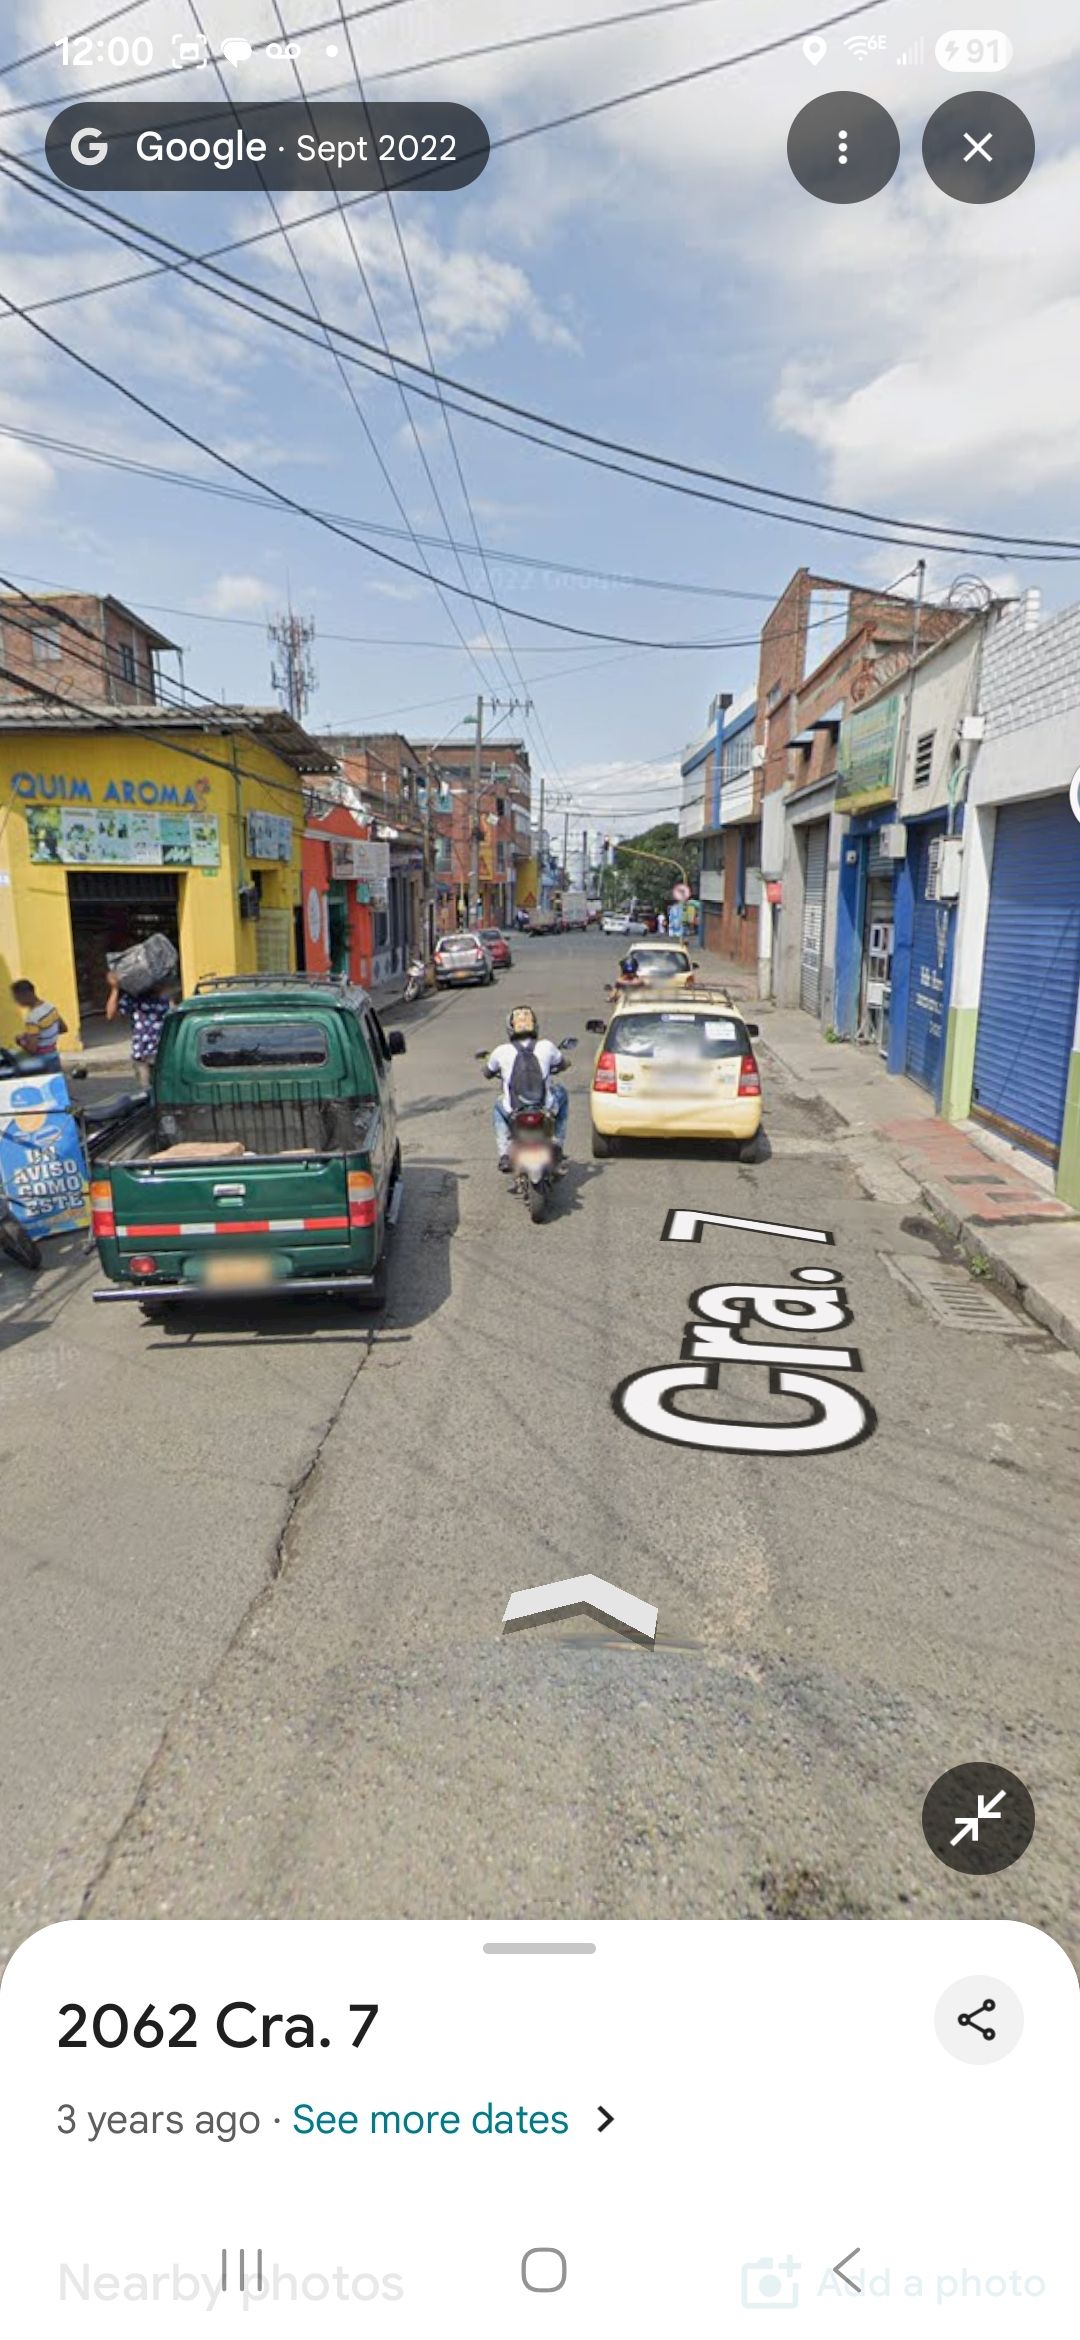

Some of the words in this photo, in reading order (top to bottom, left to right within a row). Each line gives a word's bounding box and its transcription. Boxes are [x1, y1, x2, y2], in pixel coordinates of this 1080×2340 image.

[11, 771, 91, 802] QUIM
[103, 778, 199, 806] AROMA
[14, 1159, 77, 1184] AVISO
[18, 1175, 81, 1200] COMO
[25, 1191, 83, 1217] ESTE
